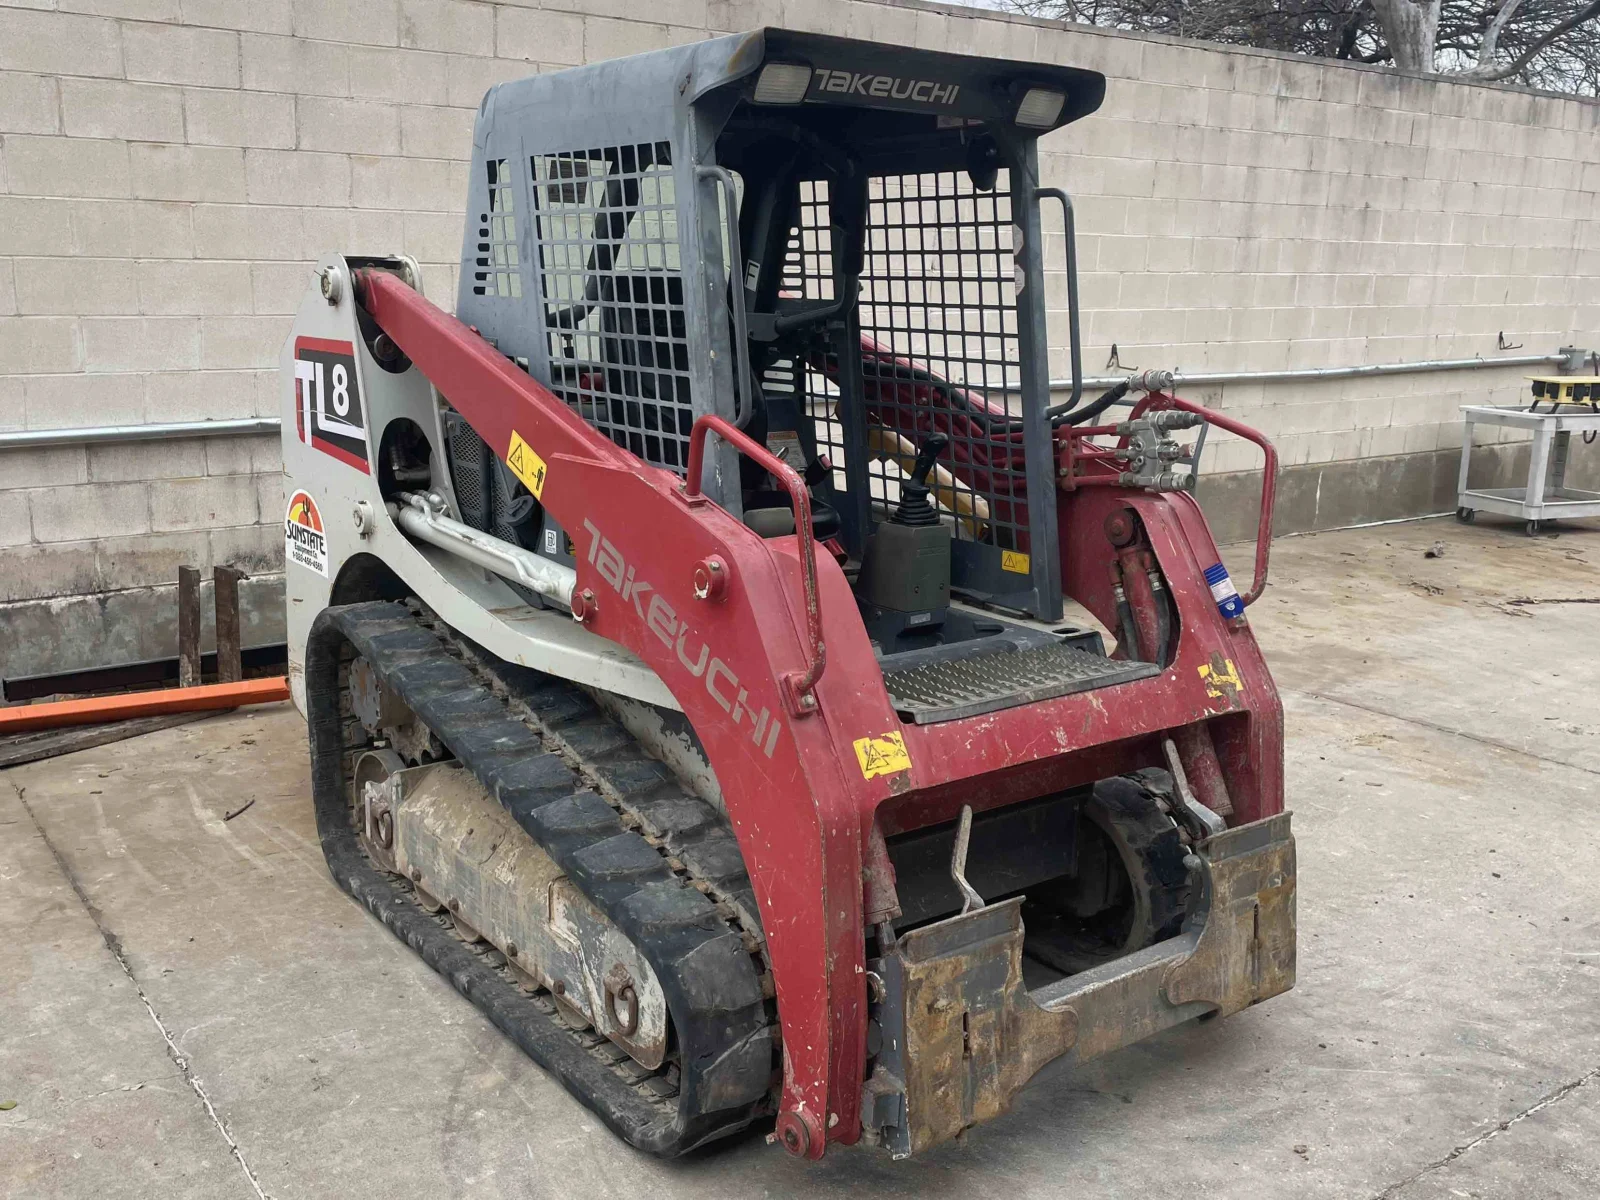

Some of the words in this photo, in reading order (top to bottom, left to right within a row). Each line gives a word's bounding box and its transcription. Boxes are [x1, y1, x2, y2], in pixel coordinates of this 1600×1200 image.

[815, 69, 960, 104] TAKEUCHI
[287, 519, 326, 556] SUNSTATE
[583, 517, 781, 759] TAKEUCHI
